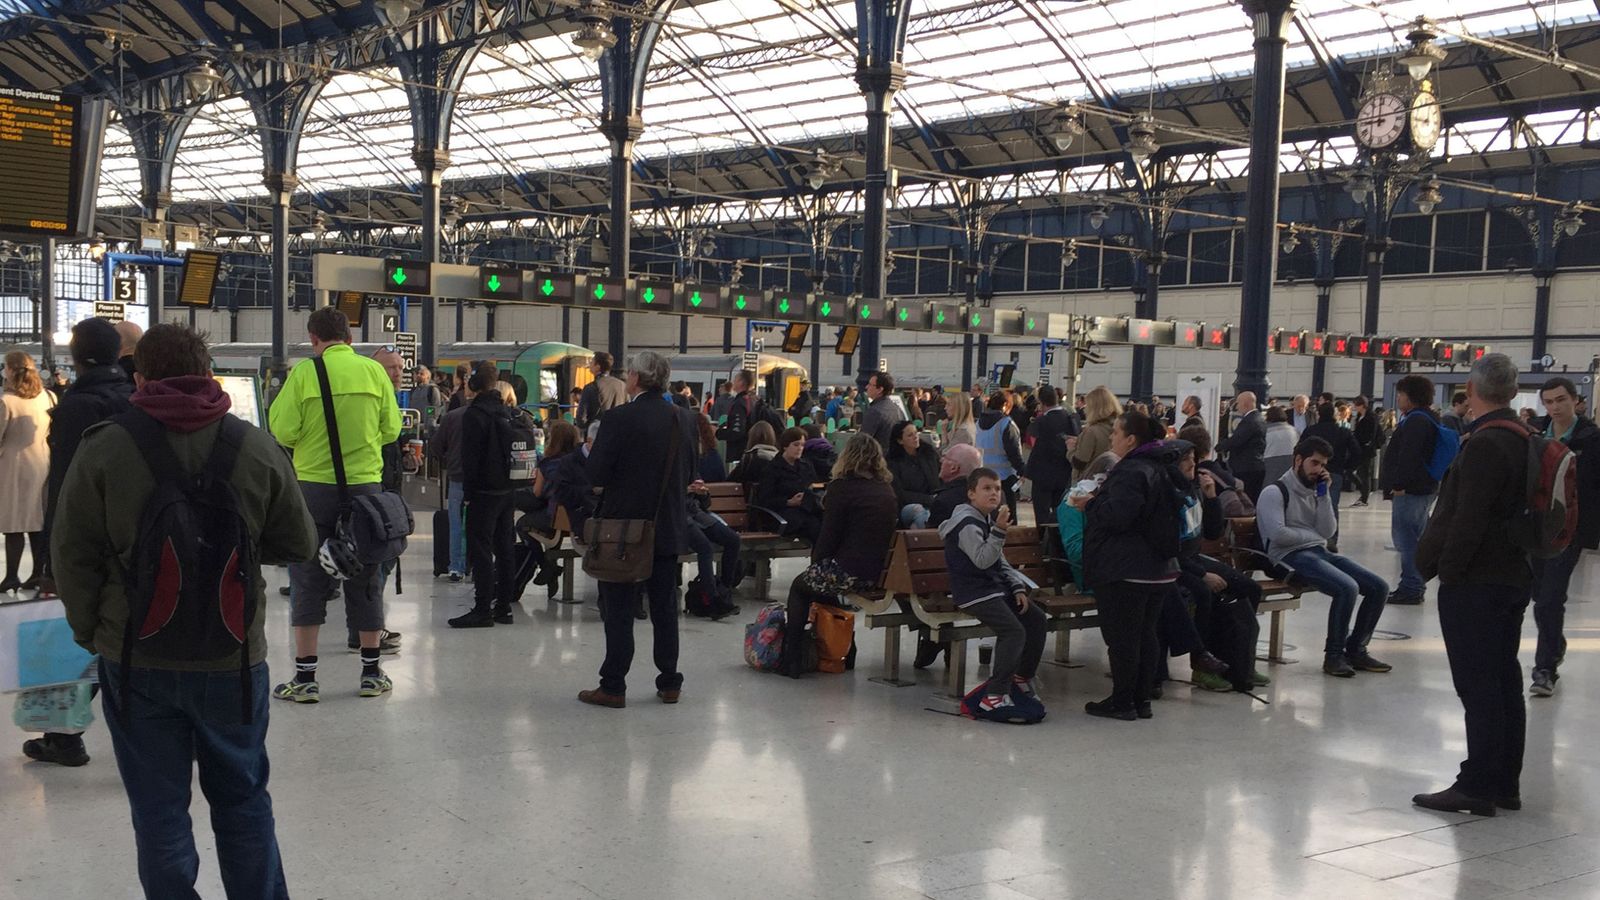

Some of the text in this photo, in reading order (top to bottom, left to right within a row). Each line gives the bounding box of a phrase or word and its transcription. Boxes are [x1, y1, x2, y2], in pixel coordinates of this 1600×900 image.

[16, 89, 60, 101] Departures
[120, 281, 131, 299] 3
[386, 317, 395, 331] 4
[755, 339, 761, 351] 5
[1047, 354, 1052, 364] 7
